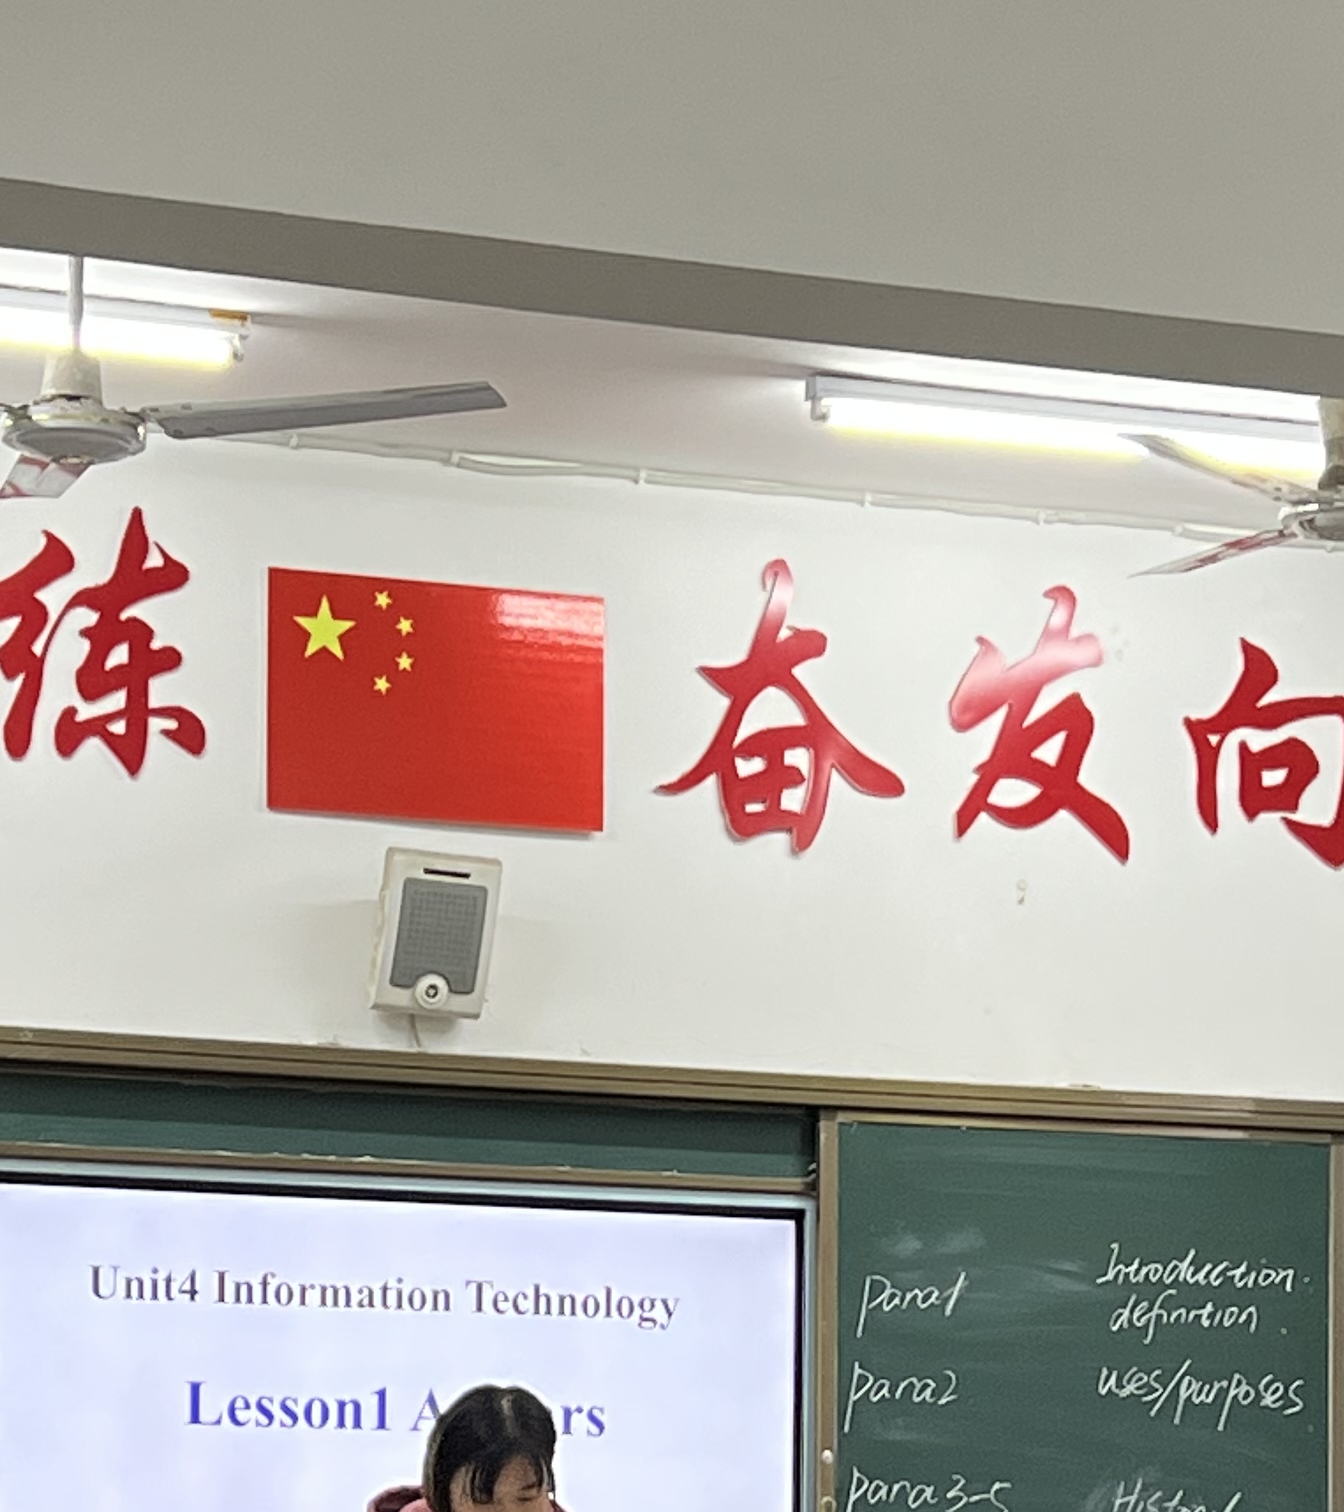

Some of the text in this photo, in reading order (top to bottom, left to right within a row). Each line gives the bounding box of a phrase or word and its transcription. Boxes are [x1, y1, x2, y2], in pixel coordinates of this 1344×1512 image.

[89, 1264, 680, 1330] Unit4 Information Technology
[187, 1380, 391, 1431] Lesson1
[843, 1361, 958, 1433] para2
